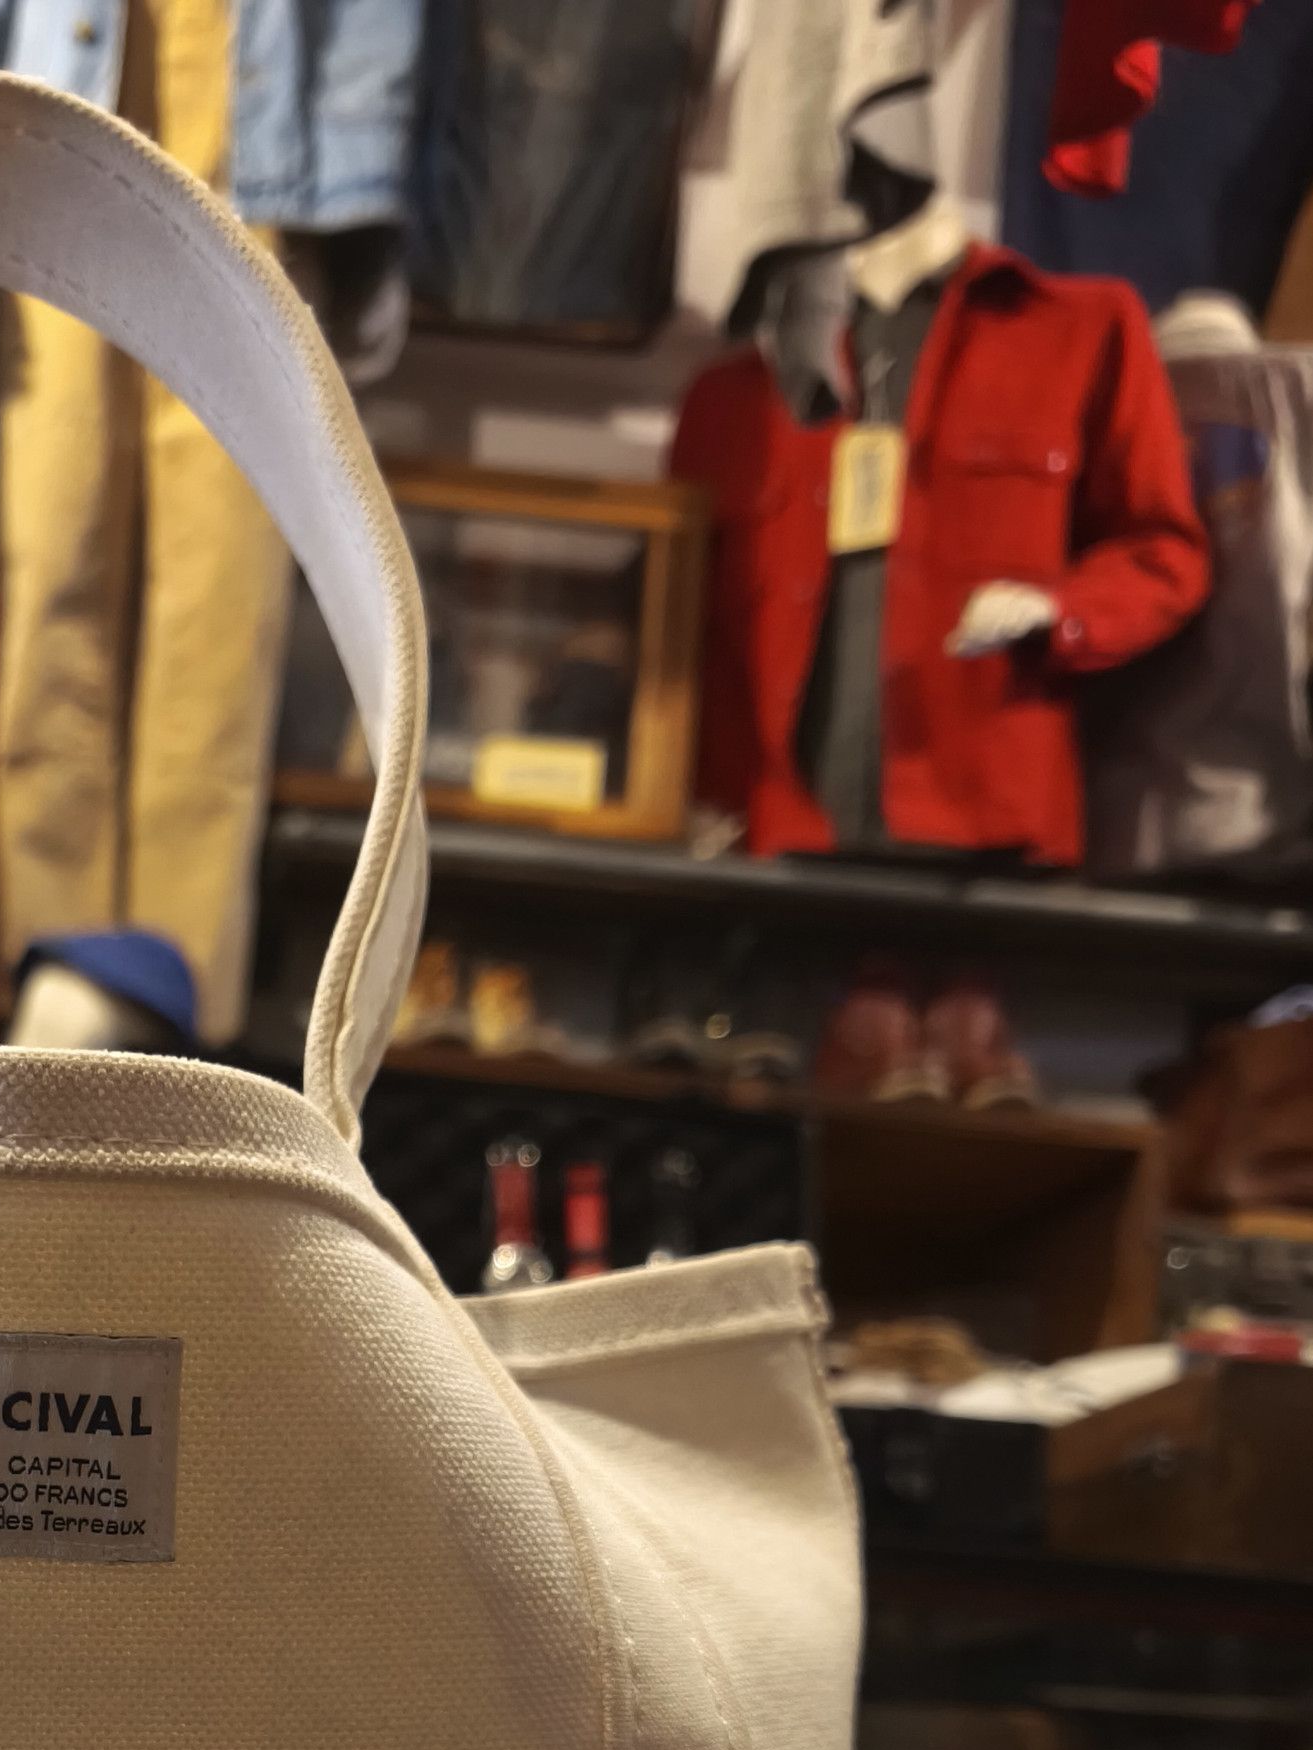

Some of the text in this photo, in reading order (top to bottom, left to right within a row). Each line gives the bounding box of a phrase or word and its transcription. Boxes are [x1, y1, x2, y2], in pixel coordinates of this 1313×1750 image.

[8, 1455, 121, 1480] CAPITAL
[35, 1484, 129, 1508] FRANCS
[40, 1509, 147, 1536] Terreaux
